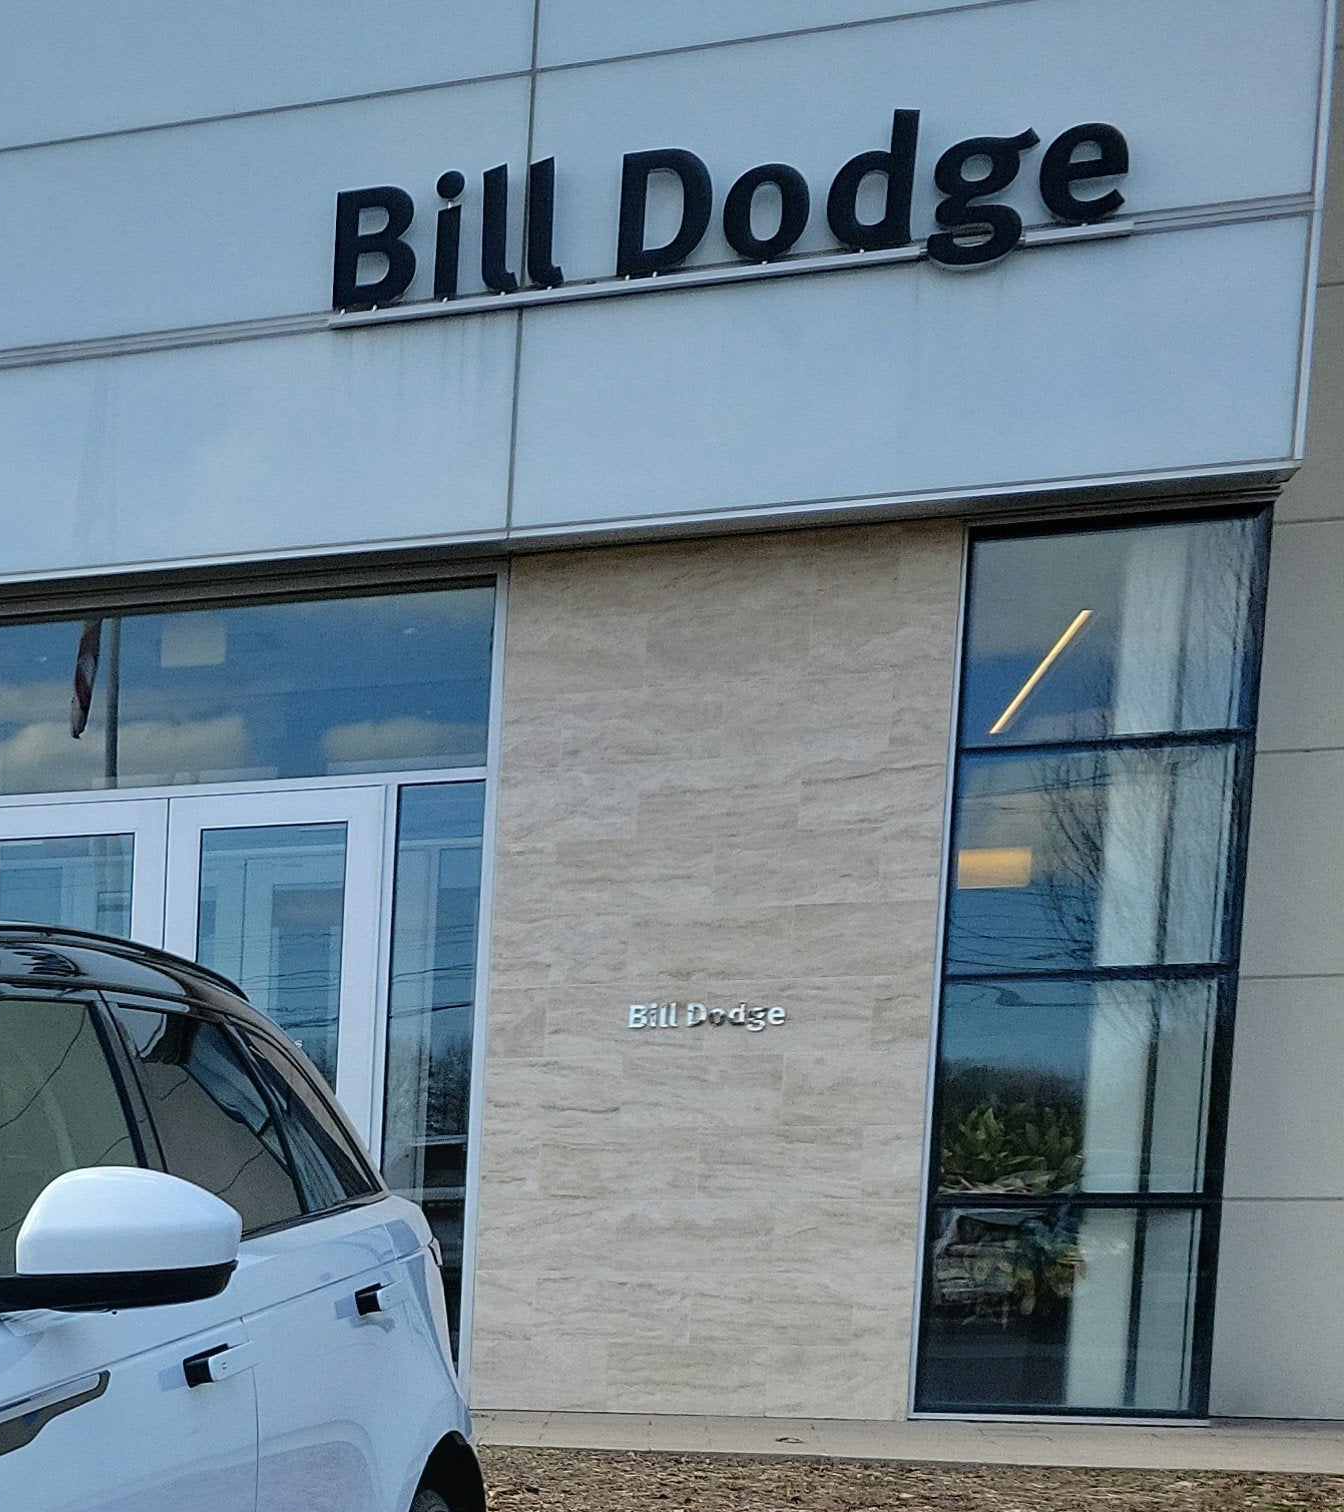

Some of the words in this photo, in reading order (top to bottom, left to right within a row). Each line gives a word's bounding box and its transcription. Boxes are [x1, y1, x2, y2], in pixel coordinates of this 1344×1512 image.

[332, 155, 564, 311] Bill
[616, 109, 1130, 269] Dodge
[627, 1002, 679, 1029] Bill
[686, 1001, 787, 1032] Dodge
